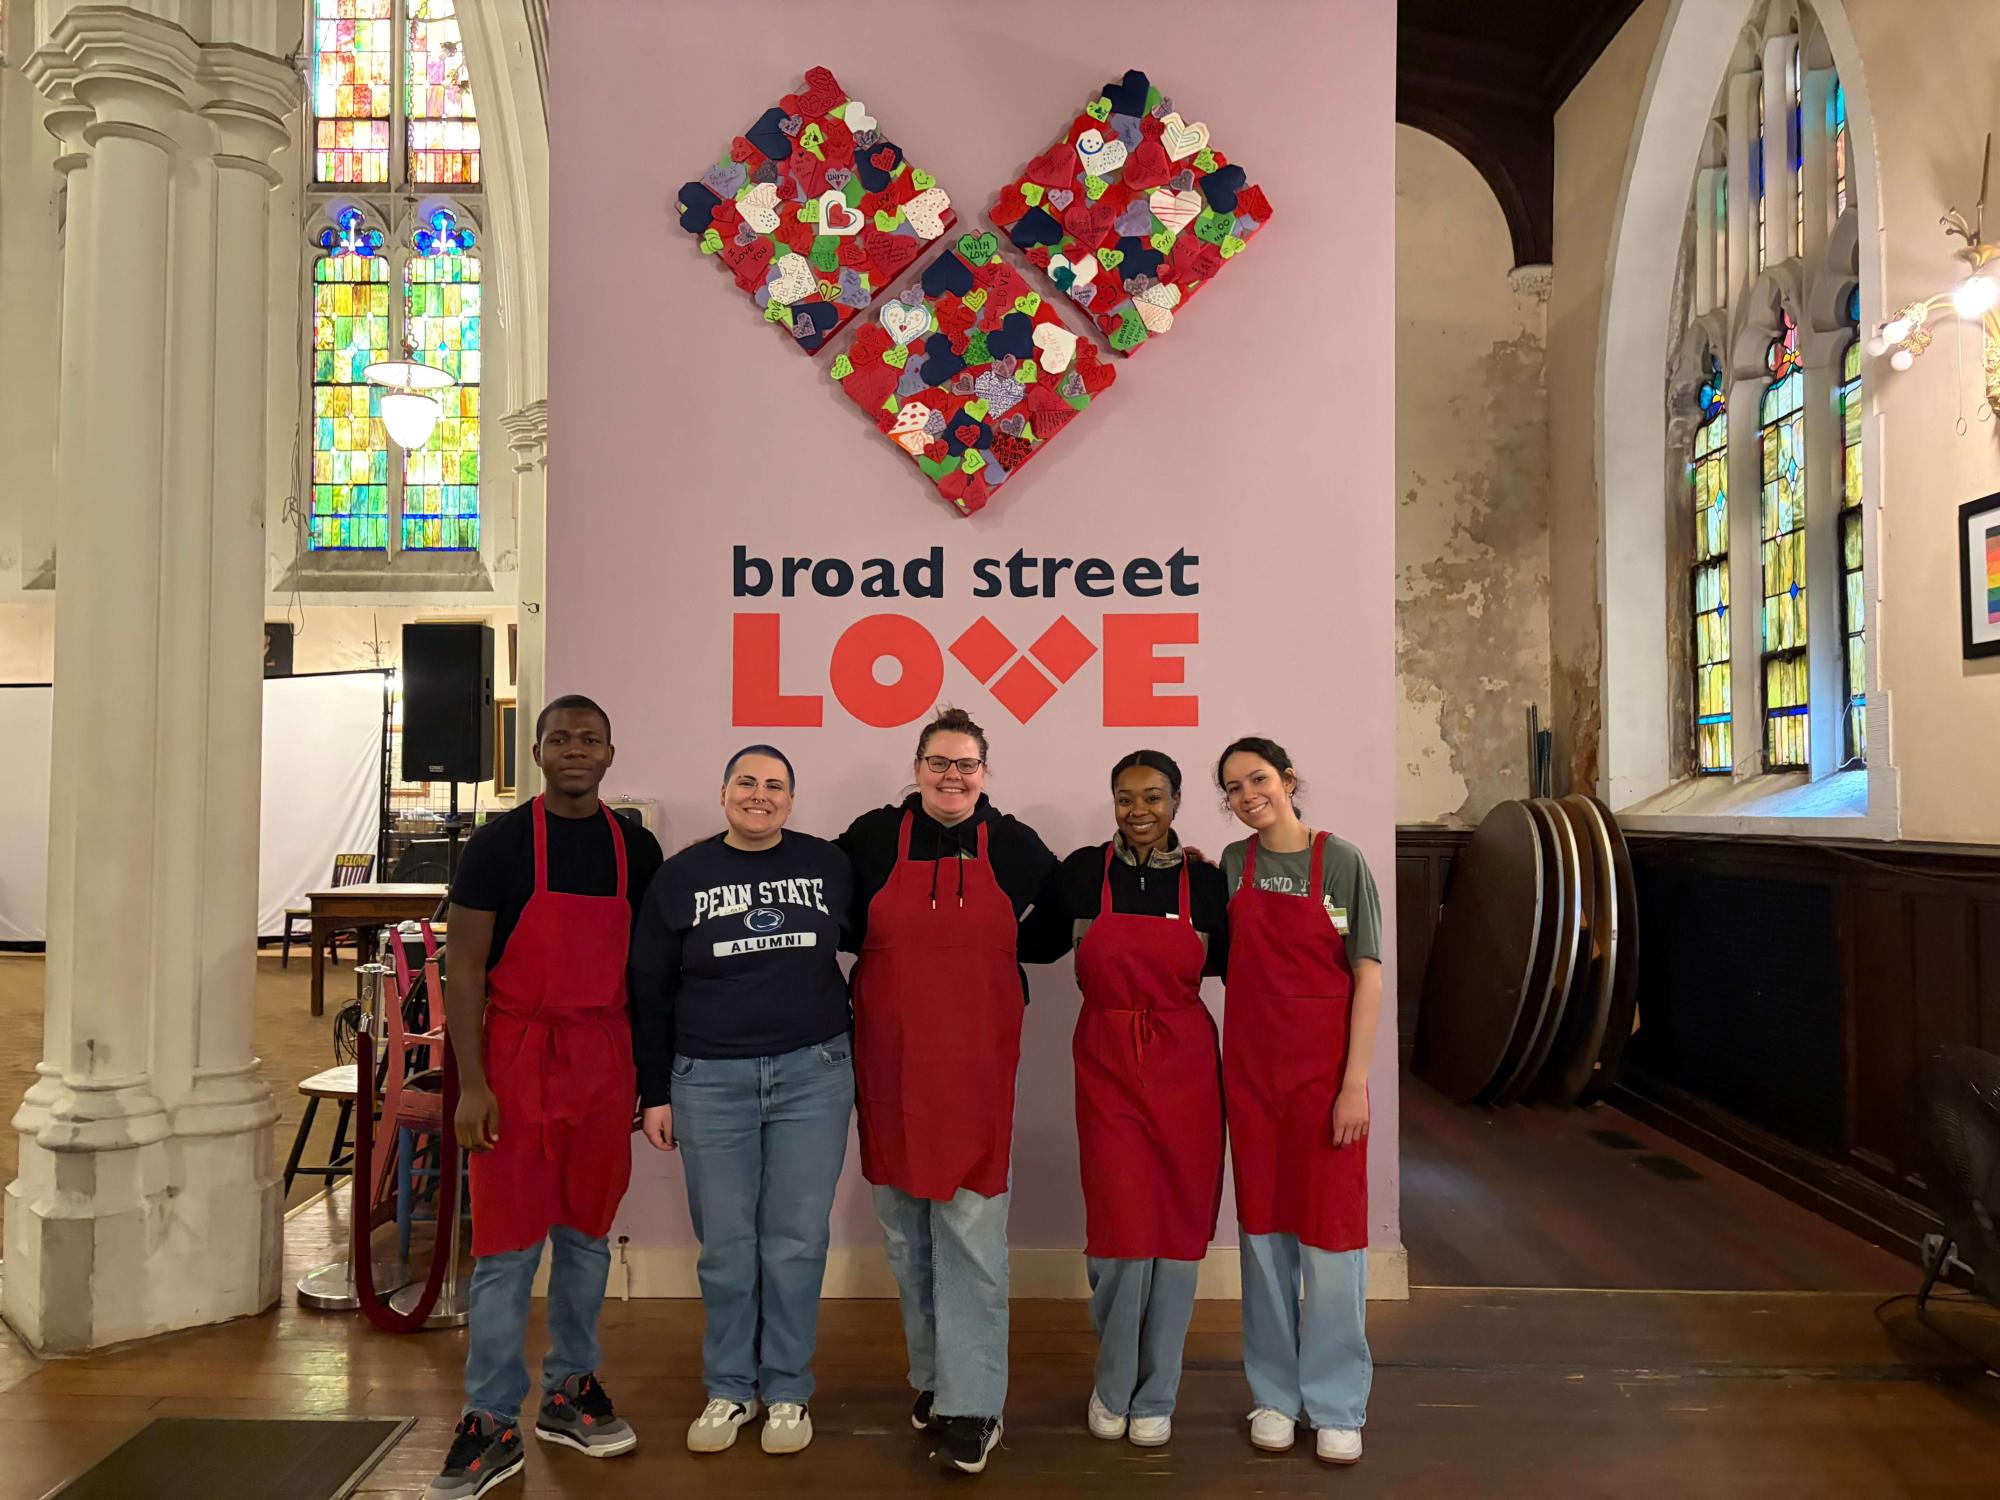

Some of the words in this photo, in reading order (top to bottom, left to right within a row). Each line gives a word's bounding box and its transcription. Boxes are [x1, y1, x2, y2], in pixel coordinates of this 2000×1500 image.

[727, 248, 735, 257] I
[733, 243, 755, 265] LOVE
[752, 246, 768, 262] YOU
[970, 249, 991, 259] LOVE
[995, 271, 1011, 307] LOVE
[732, 545, 944, 599] broad
[972, 546, 1200, 599] street
[732, 612, 1200, 729] LOVE
[692, 884, 752, 927] PENN
[758, 878, 830, 916] STATE
[731, 934, 802, 954] ALUMNI
